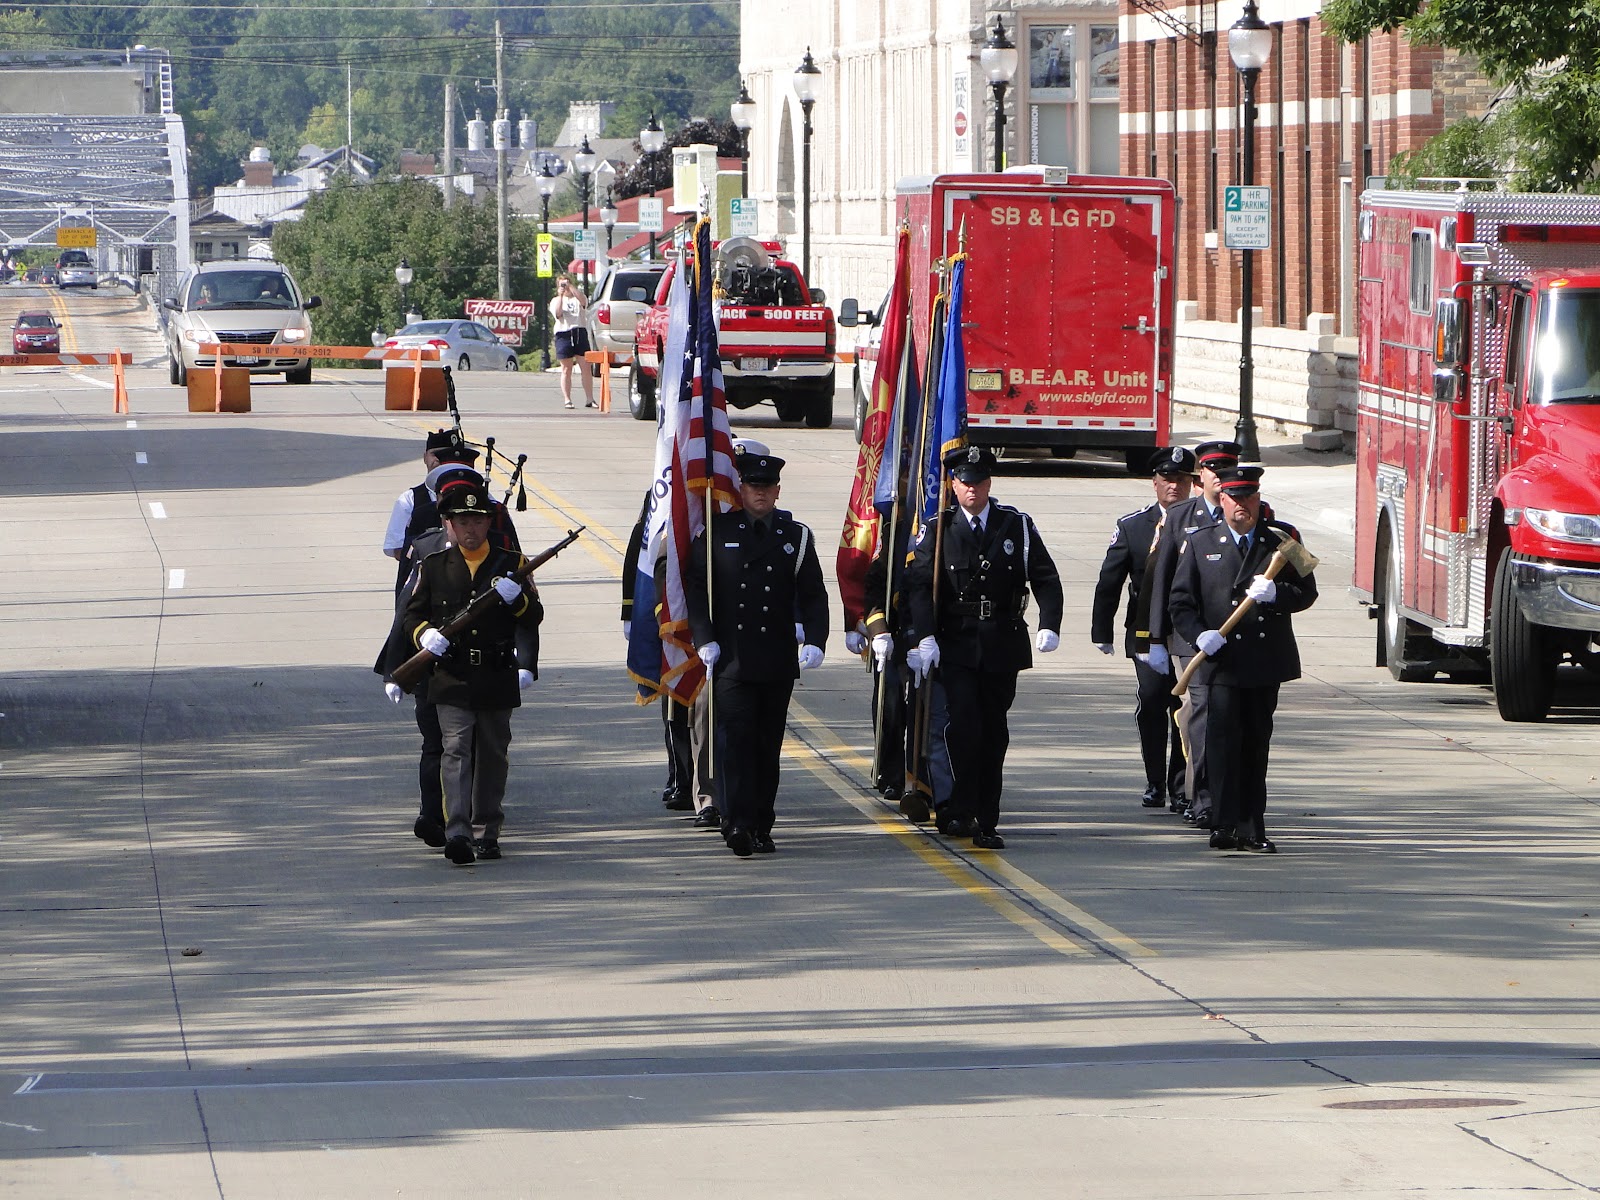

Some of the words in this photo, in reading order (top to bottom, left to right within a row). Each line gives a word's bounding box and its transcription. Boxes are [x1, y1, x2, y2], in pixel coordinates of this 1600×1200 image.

[1227, 190, 1238, 208] 2
[1241, 200, 1269, 210] PARKING
[732, 201, 739, 212] 2
[991, 206, 1021, 226] SB
[1028, 208, 1043, 226] &
[1050, 207, 1079, 227] LG
[1087, 209, 1116, 228] FD
[1230, 214, 1242, 224] 9AM
[1244, 214, 1252, 224] TO
[1254, 214, 1266, 224] 6PM
[575, 231, 582, 240] 2
[471, 302, 531, 317] Holiday
[763, 309, 792, 320] 500
[795, 310, 824, 320] FEET
[474, 315, 526, 330] MOTEL
[292, 347, 331, 356] 746-2912
[1009, 368, 1096, 386] B.E.A.R.
[1103, 370, 1148, 387] Unit
[1039, 392, 1147, 406] www.sblgfd.com
